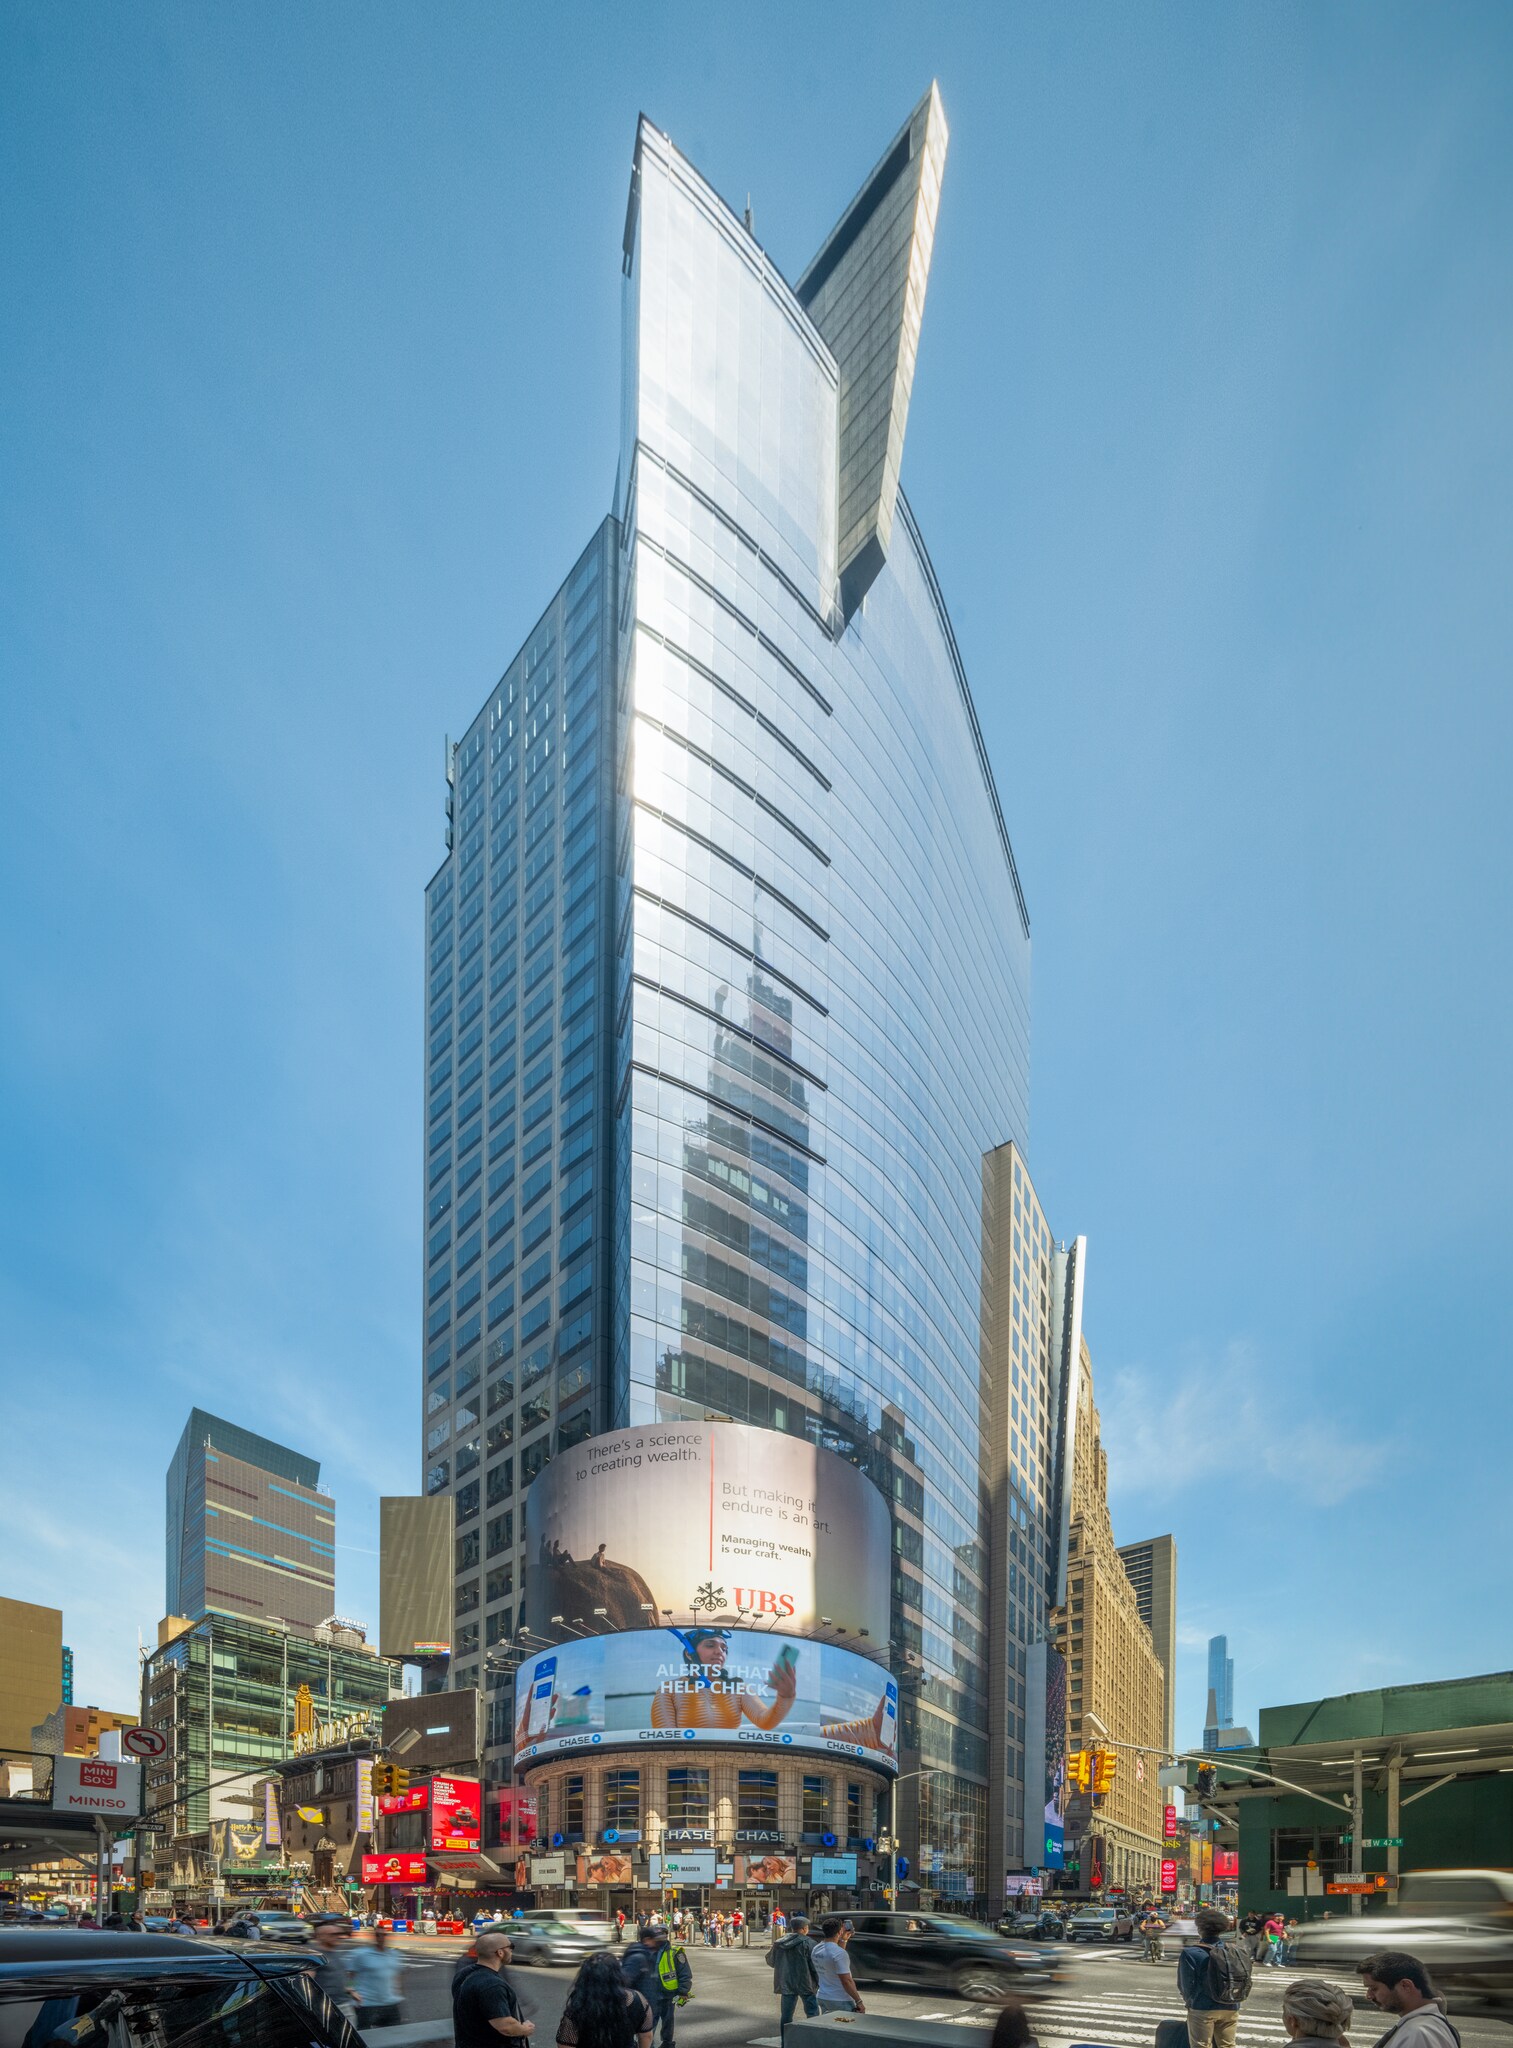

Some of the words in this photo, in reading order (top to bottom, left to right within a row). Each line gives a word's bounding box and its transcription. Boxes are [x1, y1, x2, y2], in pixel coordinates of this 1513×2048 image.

[587, 1439, 631, 1461] There's
[635, 1438, 644, 1449] a
[649, 1433, 702, 1447] science
[576, 1469, 587, 1480] to
[591, 1454, 642, 1475] creating
[647, 1448, 702, 1463] wealth.
[722, 1482, 748, 1497] But
[753, 1488, 803, 1511] making
[808, 1499, 817, 1513] it
[722, 1500, 773, 1517] endure
[778, 1506, 788, 1520] is
[793, 1513, 808, 1525] an
[813, 1519, 832, 1535] art.
[721, 1534, 775, 1551] Managing
[778, 1543, 812, 1558] wealth
[721, 1545, 730, 1554] is
[733, 1546, 752, 1556] our
[755, 1548, 782, 1561] craft.
[733, 1587, 795, 1616] UBS
[656, 1663, 722, 1677] ALERTS
[724, 1664, 773, 1681] THAT
[660, 1681, 705, 1694] HELP
[710, 1681, 769, 1698] CHECK
[559, 1736, 590, 1748] CHASE
[639, 1730, 681, 1740] CHASE
[738, 1731, 780, 1742] CHASE
[827, 1740, 856, 1754] CHASE
[84, 1766, 113, 1776] MINI
[84, 1776, 101, 1784] SO
[69, 1795, 126, 1809] MINISO
[735, 1831, 785, 1842] CHASE
